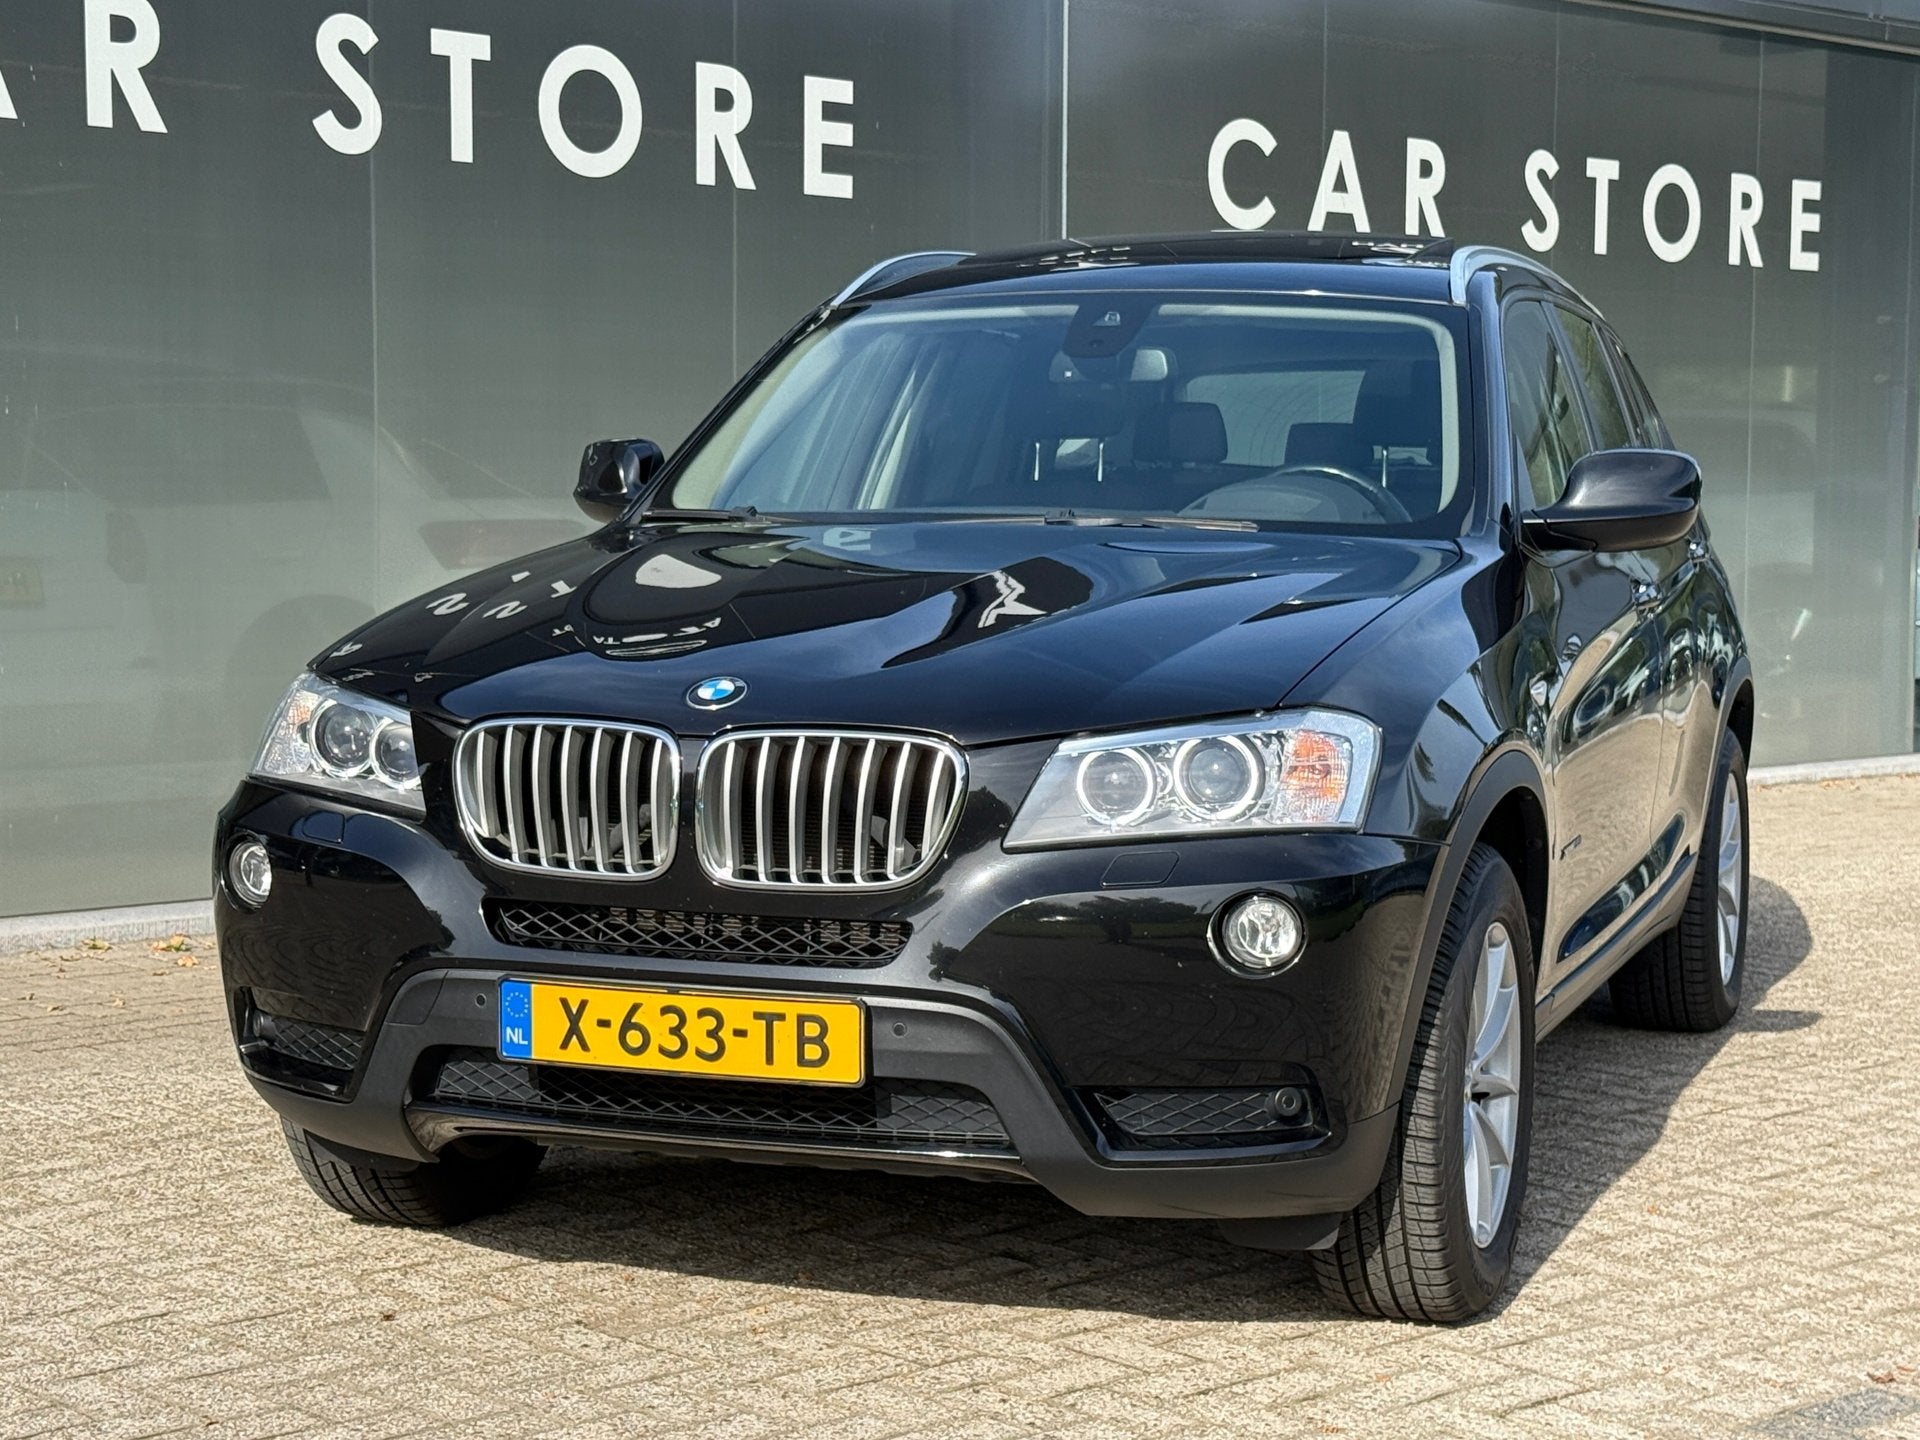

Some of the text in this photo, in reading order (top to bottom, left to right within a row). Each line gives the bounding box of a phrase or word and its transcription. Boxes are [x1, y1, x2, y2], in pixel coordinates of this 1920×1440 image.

[0, 0, 854, 199] R STORE
[1207, 118, 1822, 271] CAR STORE
[506, 1027, 528, 1045] NL
[558, 997, 830, 1068] X-633-TB
